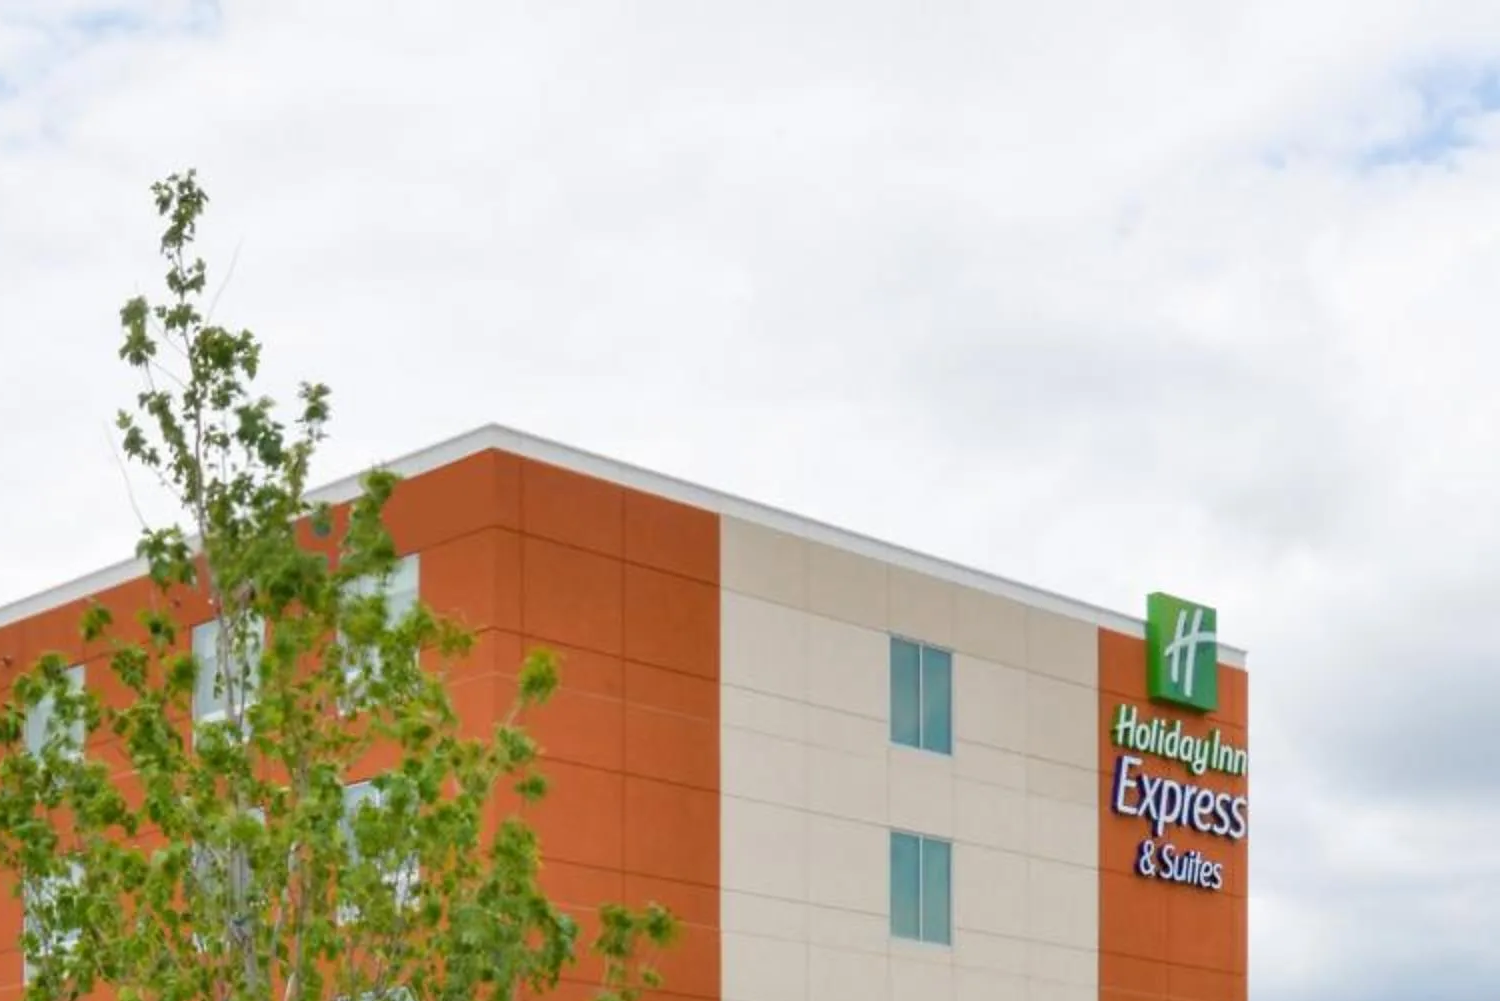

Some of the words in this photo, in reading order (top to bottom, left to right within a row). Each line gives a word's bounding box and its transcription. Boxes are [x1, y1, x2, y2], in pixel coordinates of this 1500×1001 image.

[1114, 703, 1209, 775] Holiday
[1209, 728, 1248, 777] Inn
[1112, 755, 1248, 840] Express
[1136, 839, 1156, 877] &
[1158, 842, 1223, 890] Suites
